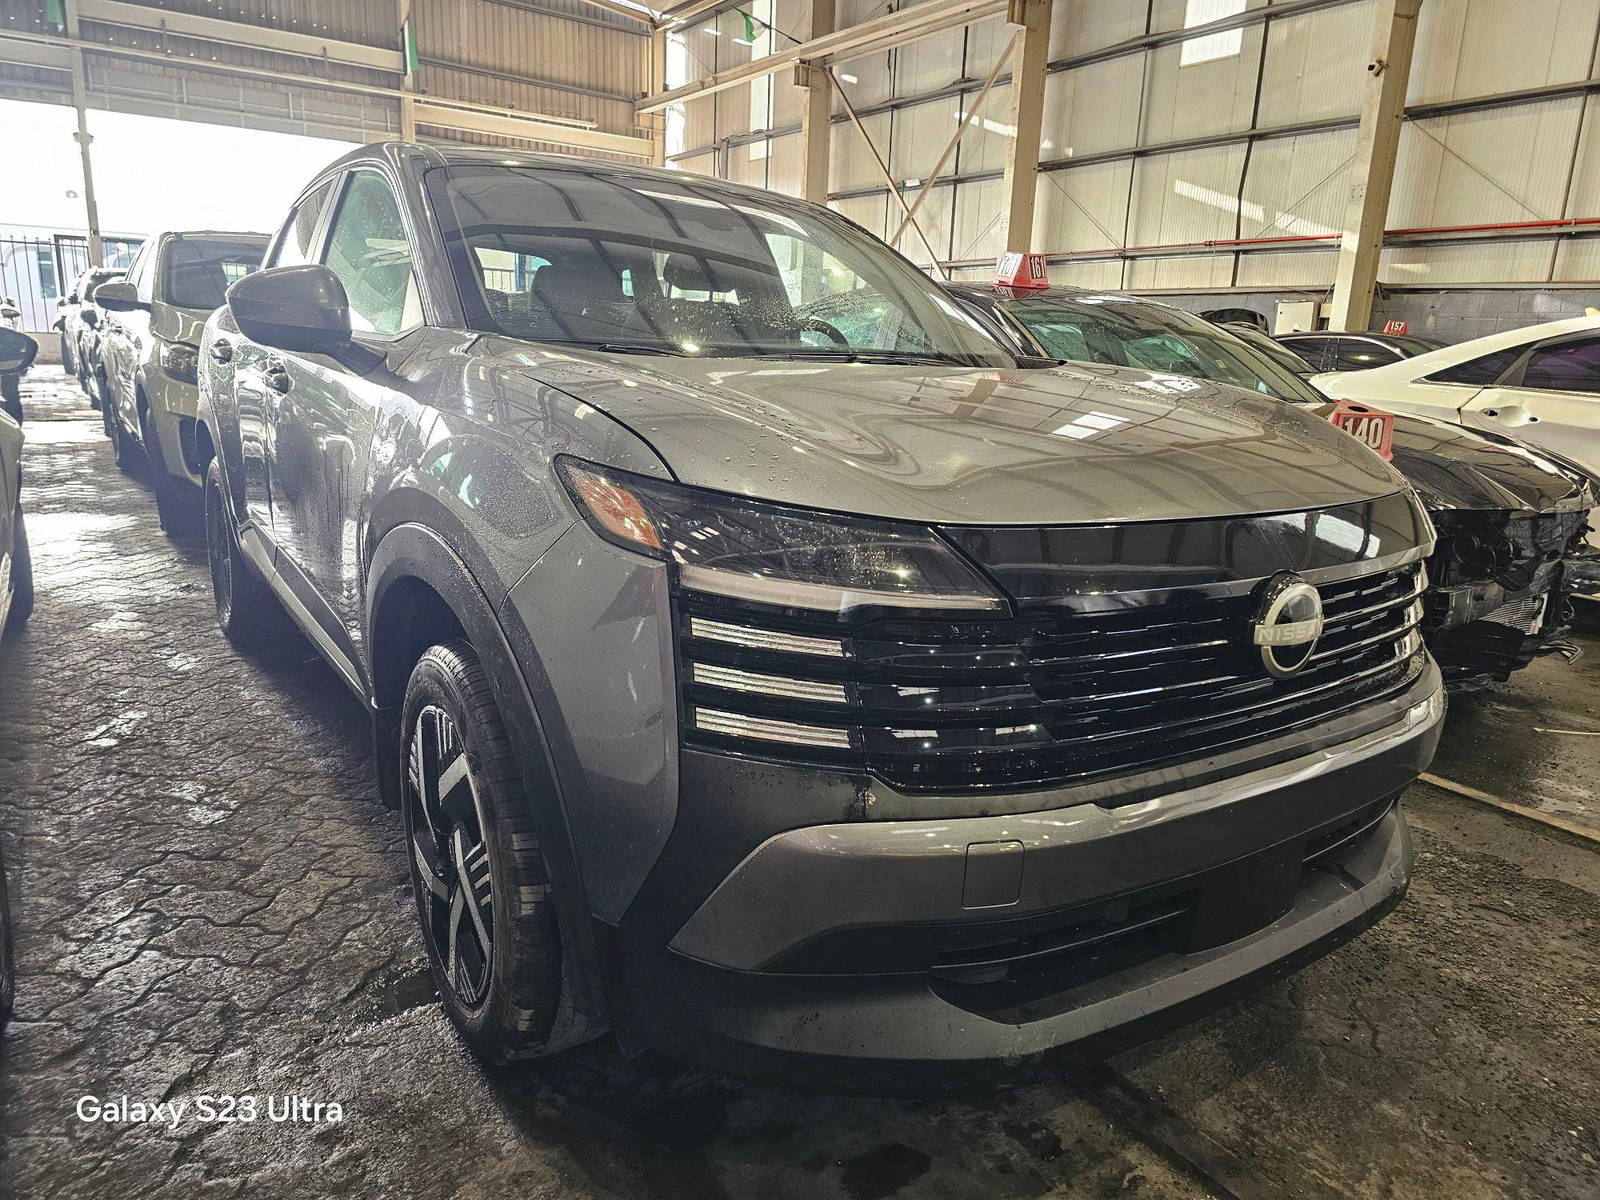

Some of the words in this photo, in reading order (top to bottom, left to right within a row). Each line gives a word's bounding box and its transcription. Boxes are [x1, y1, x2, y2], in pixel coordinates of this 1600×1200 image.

[1030, 256, 1046, 278] 161
[1390, 321, 1405, 331] 157
[1344, 417, 1384, 449] 140
